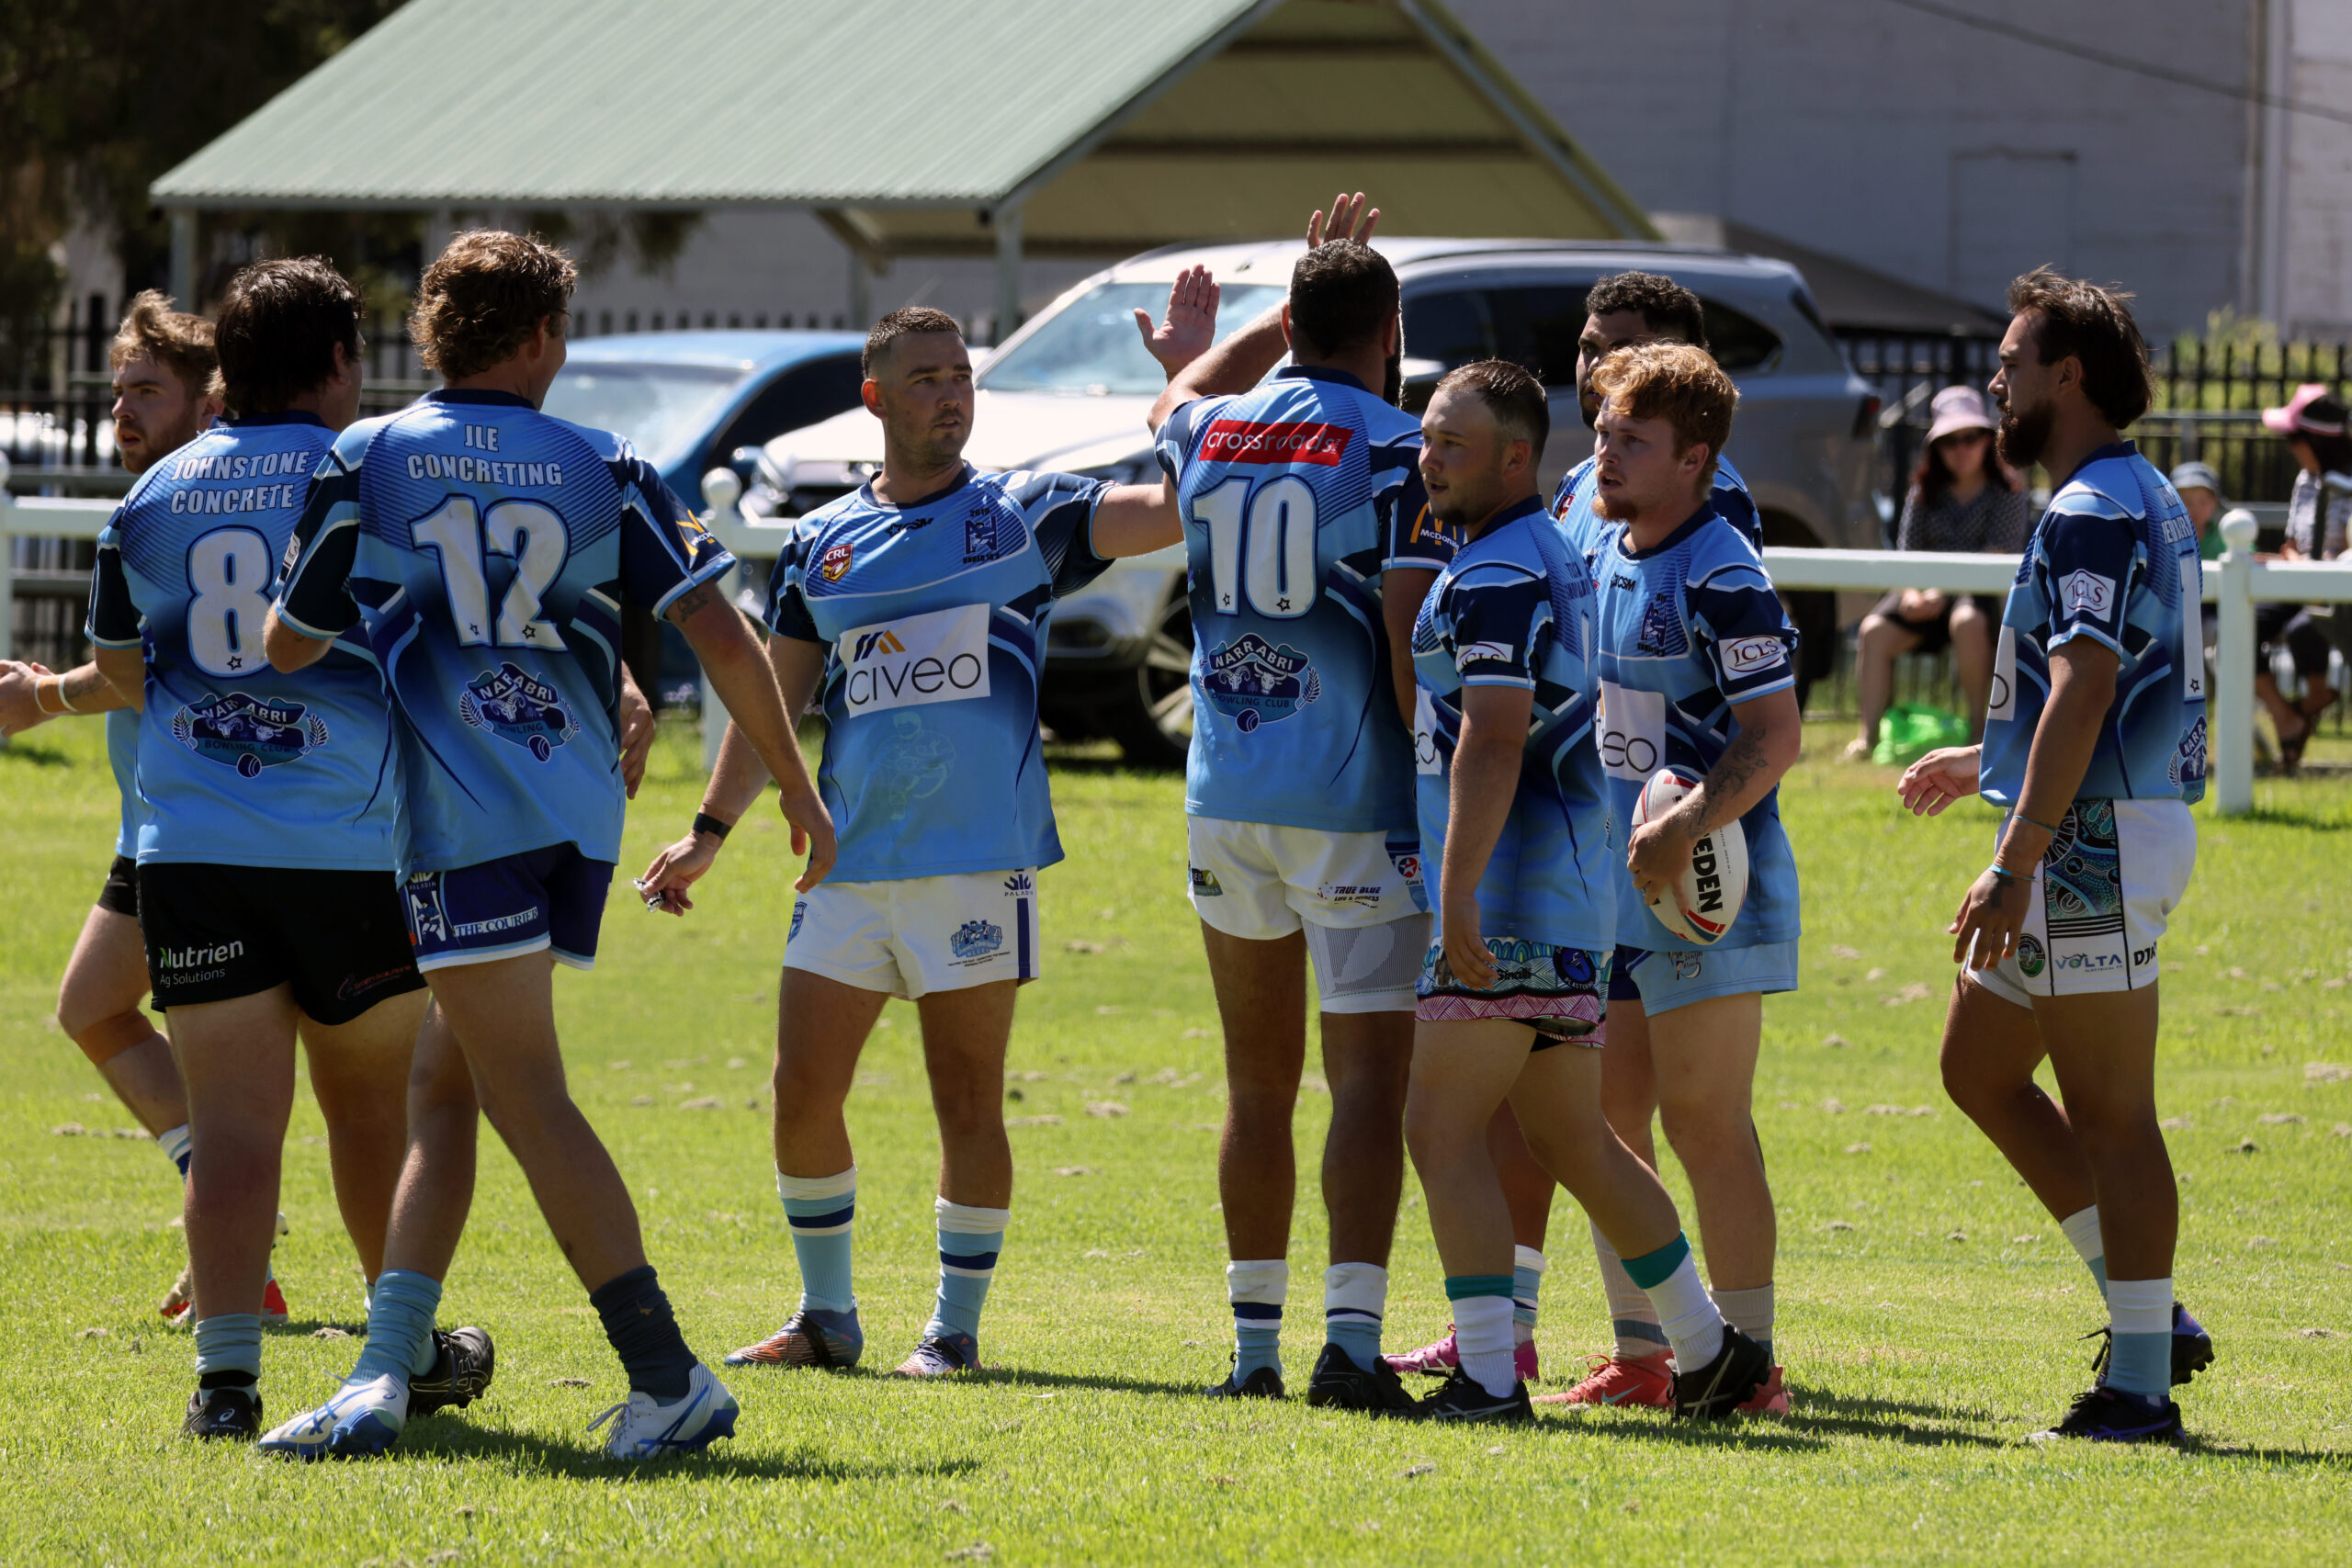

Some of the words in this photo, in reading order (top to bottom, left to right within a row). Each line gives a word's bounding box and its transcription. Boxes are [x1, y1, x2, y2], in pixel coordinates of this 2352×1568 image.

[464, 424, 499, 452] JLE
[1207, 429, 1335, 453] crossroads
[171, 451, 311, 481] JOHNSTONE
[407, 453, 563, 487] CONCRETING
[170, 483, 294, 514] CONCRETE
[825, 547, 850, 562] CRL
[1193, 474, 1318, 620] 10
[408, 492, 571, 651] 12
[186, 525, 274, 680] 8
[1216, 641, 1294, 671] NARRABRI
[1733, 640, 1779, 664] JCLS
[849, 653, 981, 705] civeo
[1265, 698, 1290, 708] CLUB
[205, 739, 255, 752] BOWLING
[262, 742, 291, 752] CLUB
[456, 922, 482, 936] THE
[485, 908, 538, 933] COURIER
[160, 941, 243, 968] Nutrien
[2055, 953, 2122, 970] VOLTA
[160, 975, 171, 987] Ag
[173, 968, 226, 985] Solutions
